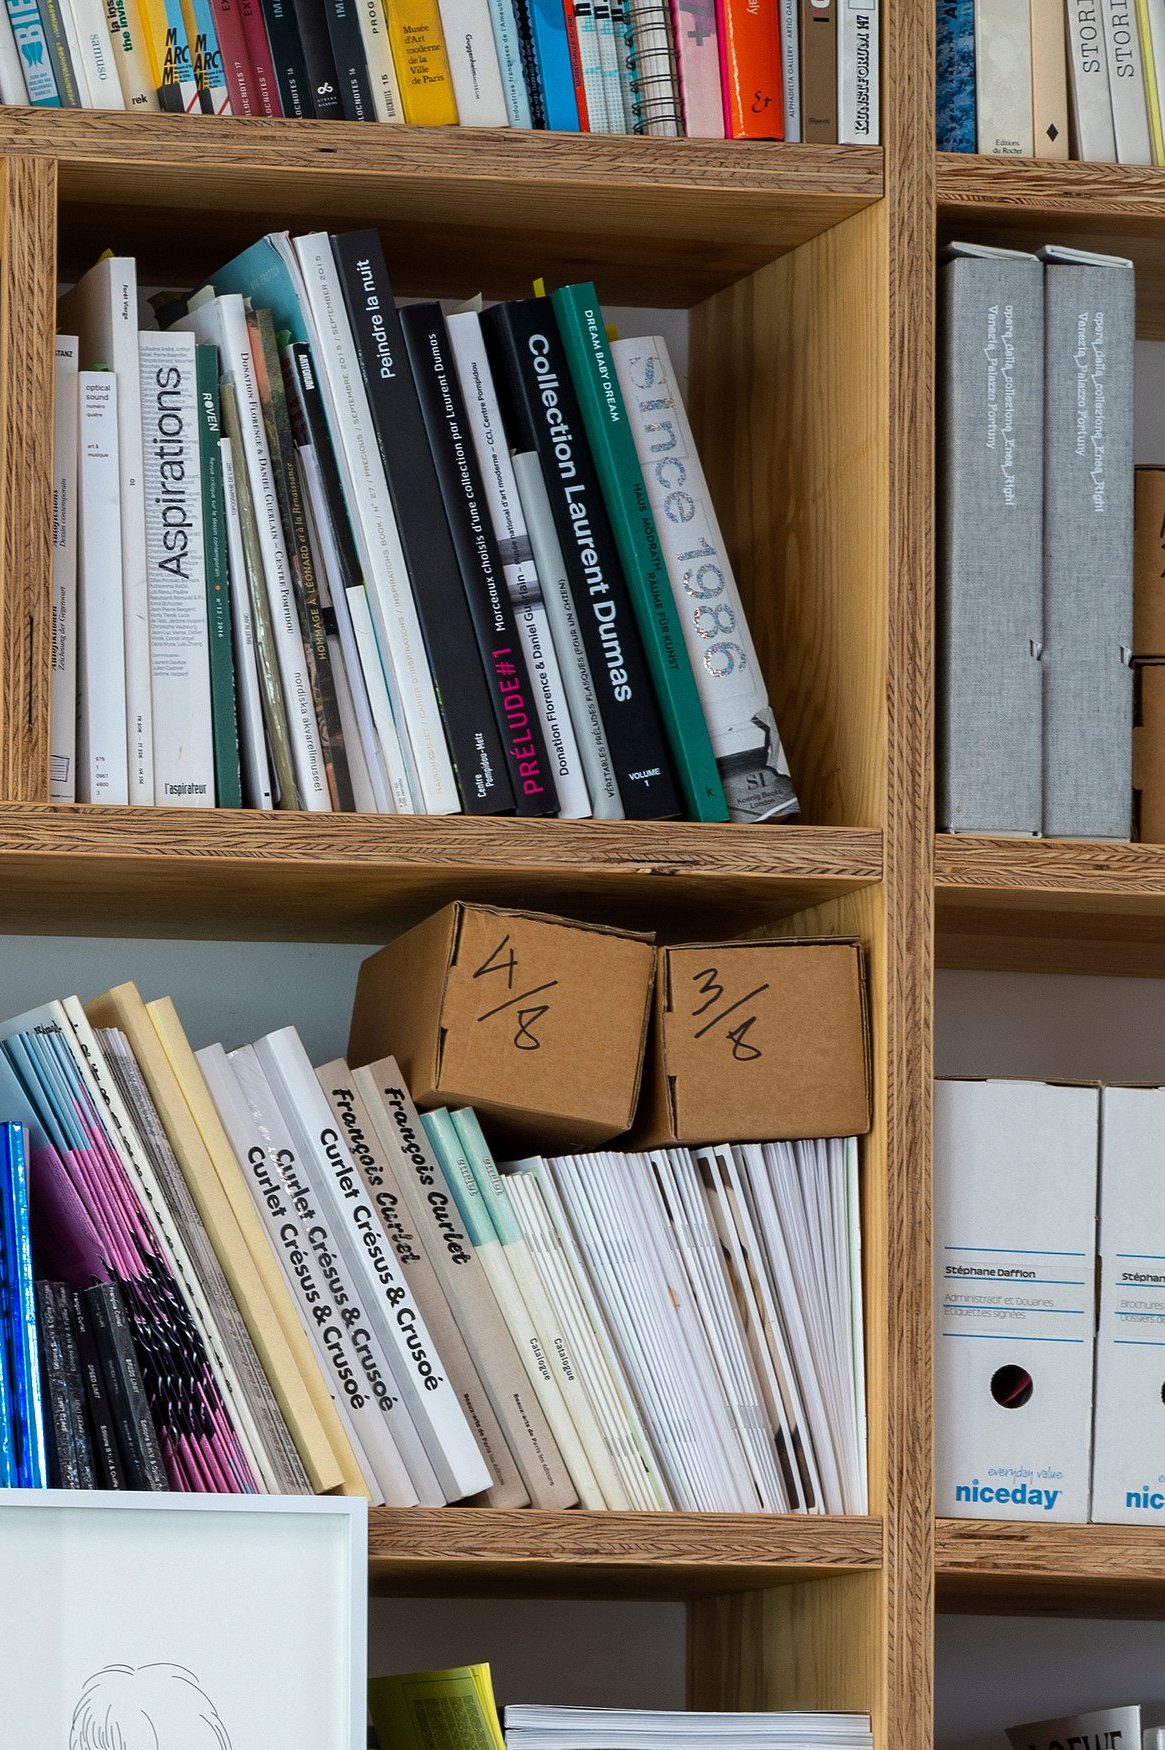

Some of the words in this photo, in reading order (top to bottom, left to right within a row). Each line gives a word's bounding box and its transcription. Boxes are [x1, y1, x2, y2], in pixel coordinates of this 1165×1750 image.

[402, 24, 430, 34] Musée
[856, 14, 869, 33] 147
[404, 35, 426, 44] d'Art
[405, 44, 442, 54] moderne
[408, 56, 418, 64] de
[419, 55, 427, 64] la
[410, 65, 429, 74] Ville
[412, 75, 421, 84] de
[422, 73, 444, 84] Paris
[854, 35, 870, 136] KUNSTFORUM
[1003, 146, 1023, 155] Rocher
[356, 260, 377, 294] nuit
[366, 296, 382, 313] la
[584, 309, 607, 353] DREAM
[368, 318, 398, 379] Peindre
[594, 353, 614, 383] BABY
[86, 383, 111, 393] optical
[86, 393, 109, 401] sound
[601, 383, 621, 422] DREAM
[155, 366, 189, 581] Aspirations
[529, 333, 576, 478] Collection
[564, 487, 608, 596] Laurent
[590, 602, 632, 703] Dumas
[628, 356, 697, 524] Since
[676, 538, 748, 680] 1986
[501, 647, 544, 795] PRÉLUDE#1
[472, 934, 559, 1051] 4/8
[692, 968, 770, 1062] 3/8
[319, 1129, 360, 1201] Curlet
[353, 1203, 394, 1287] Crésus
[385, 1286, 407, 1310] &
[396, 1306, 444, 1391] Crusoé
[945, 1265, 995, 1276] Stéphane
[997, 1268, 1036, 1278] Dafflon
[955, 1479, 1061, 1509] niceday
